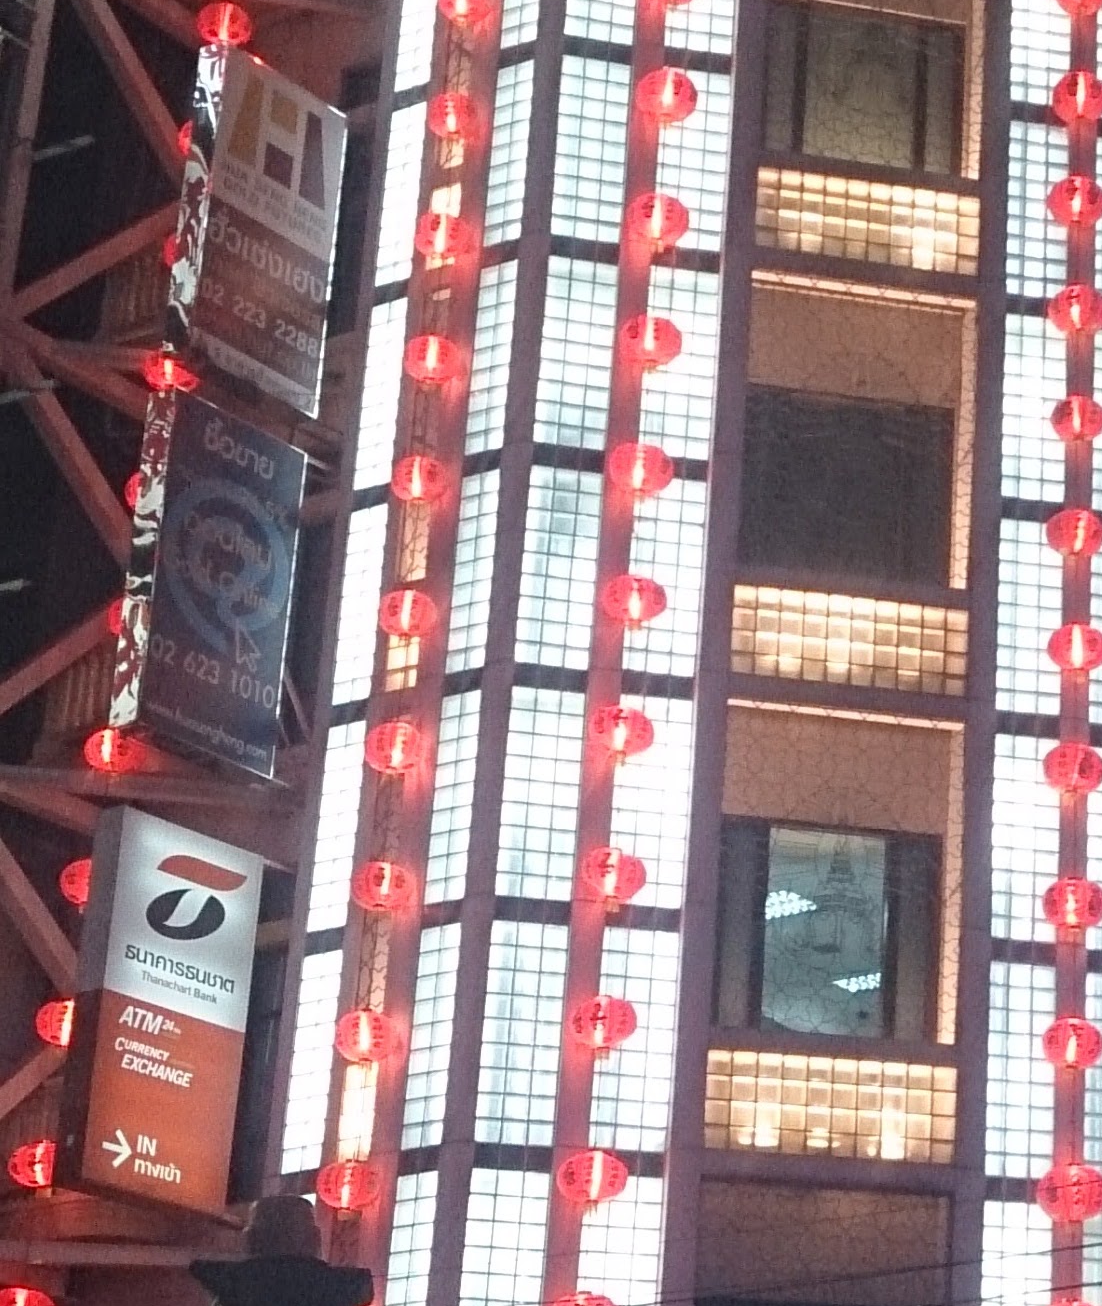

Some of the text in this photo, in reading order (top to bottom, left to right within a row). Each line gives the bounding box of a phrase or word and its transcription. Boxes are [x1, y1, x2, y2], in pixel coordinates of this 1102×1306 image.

[232, 295, 266, 329] 223
[274, 319, 319, 359] 2288
[151, 633, 275, 709] 02 623 1010
[125, 944, 235, 994] ธนาคารธนชาต
[141, 970, 218, 1005] Thanachart Bank
[118, 1005, 163, 1035] ATM
[121, 1054, 193, 1088] EXCHANGE
[136, 1134, 157, 1157] IN
[134, 1158, 181, 1184] ทางเข้า
